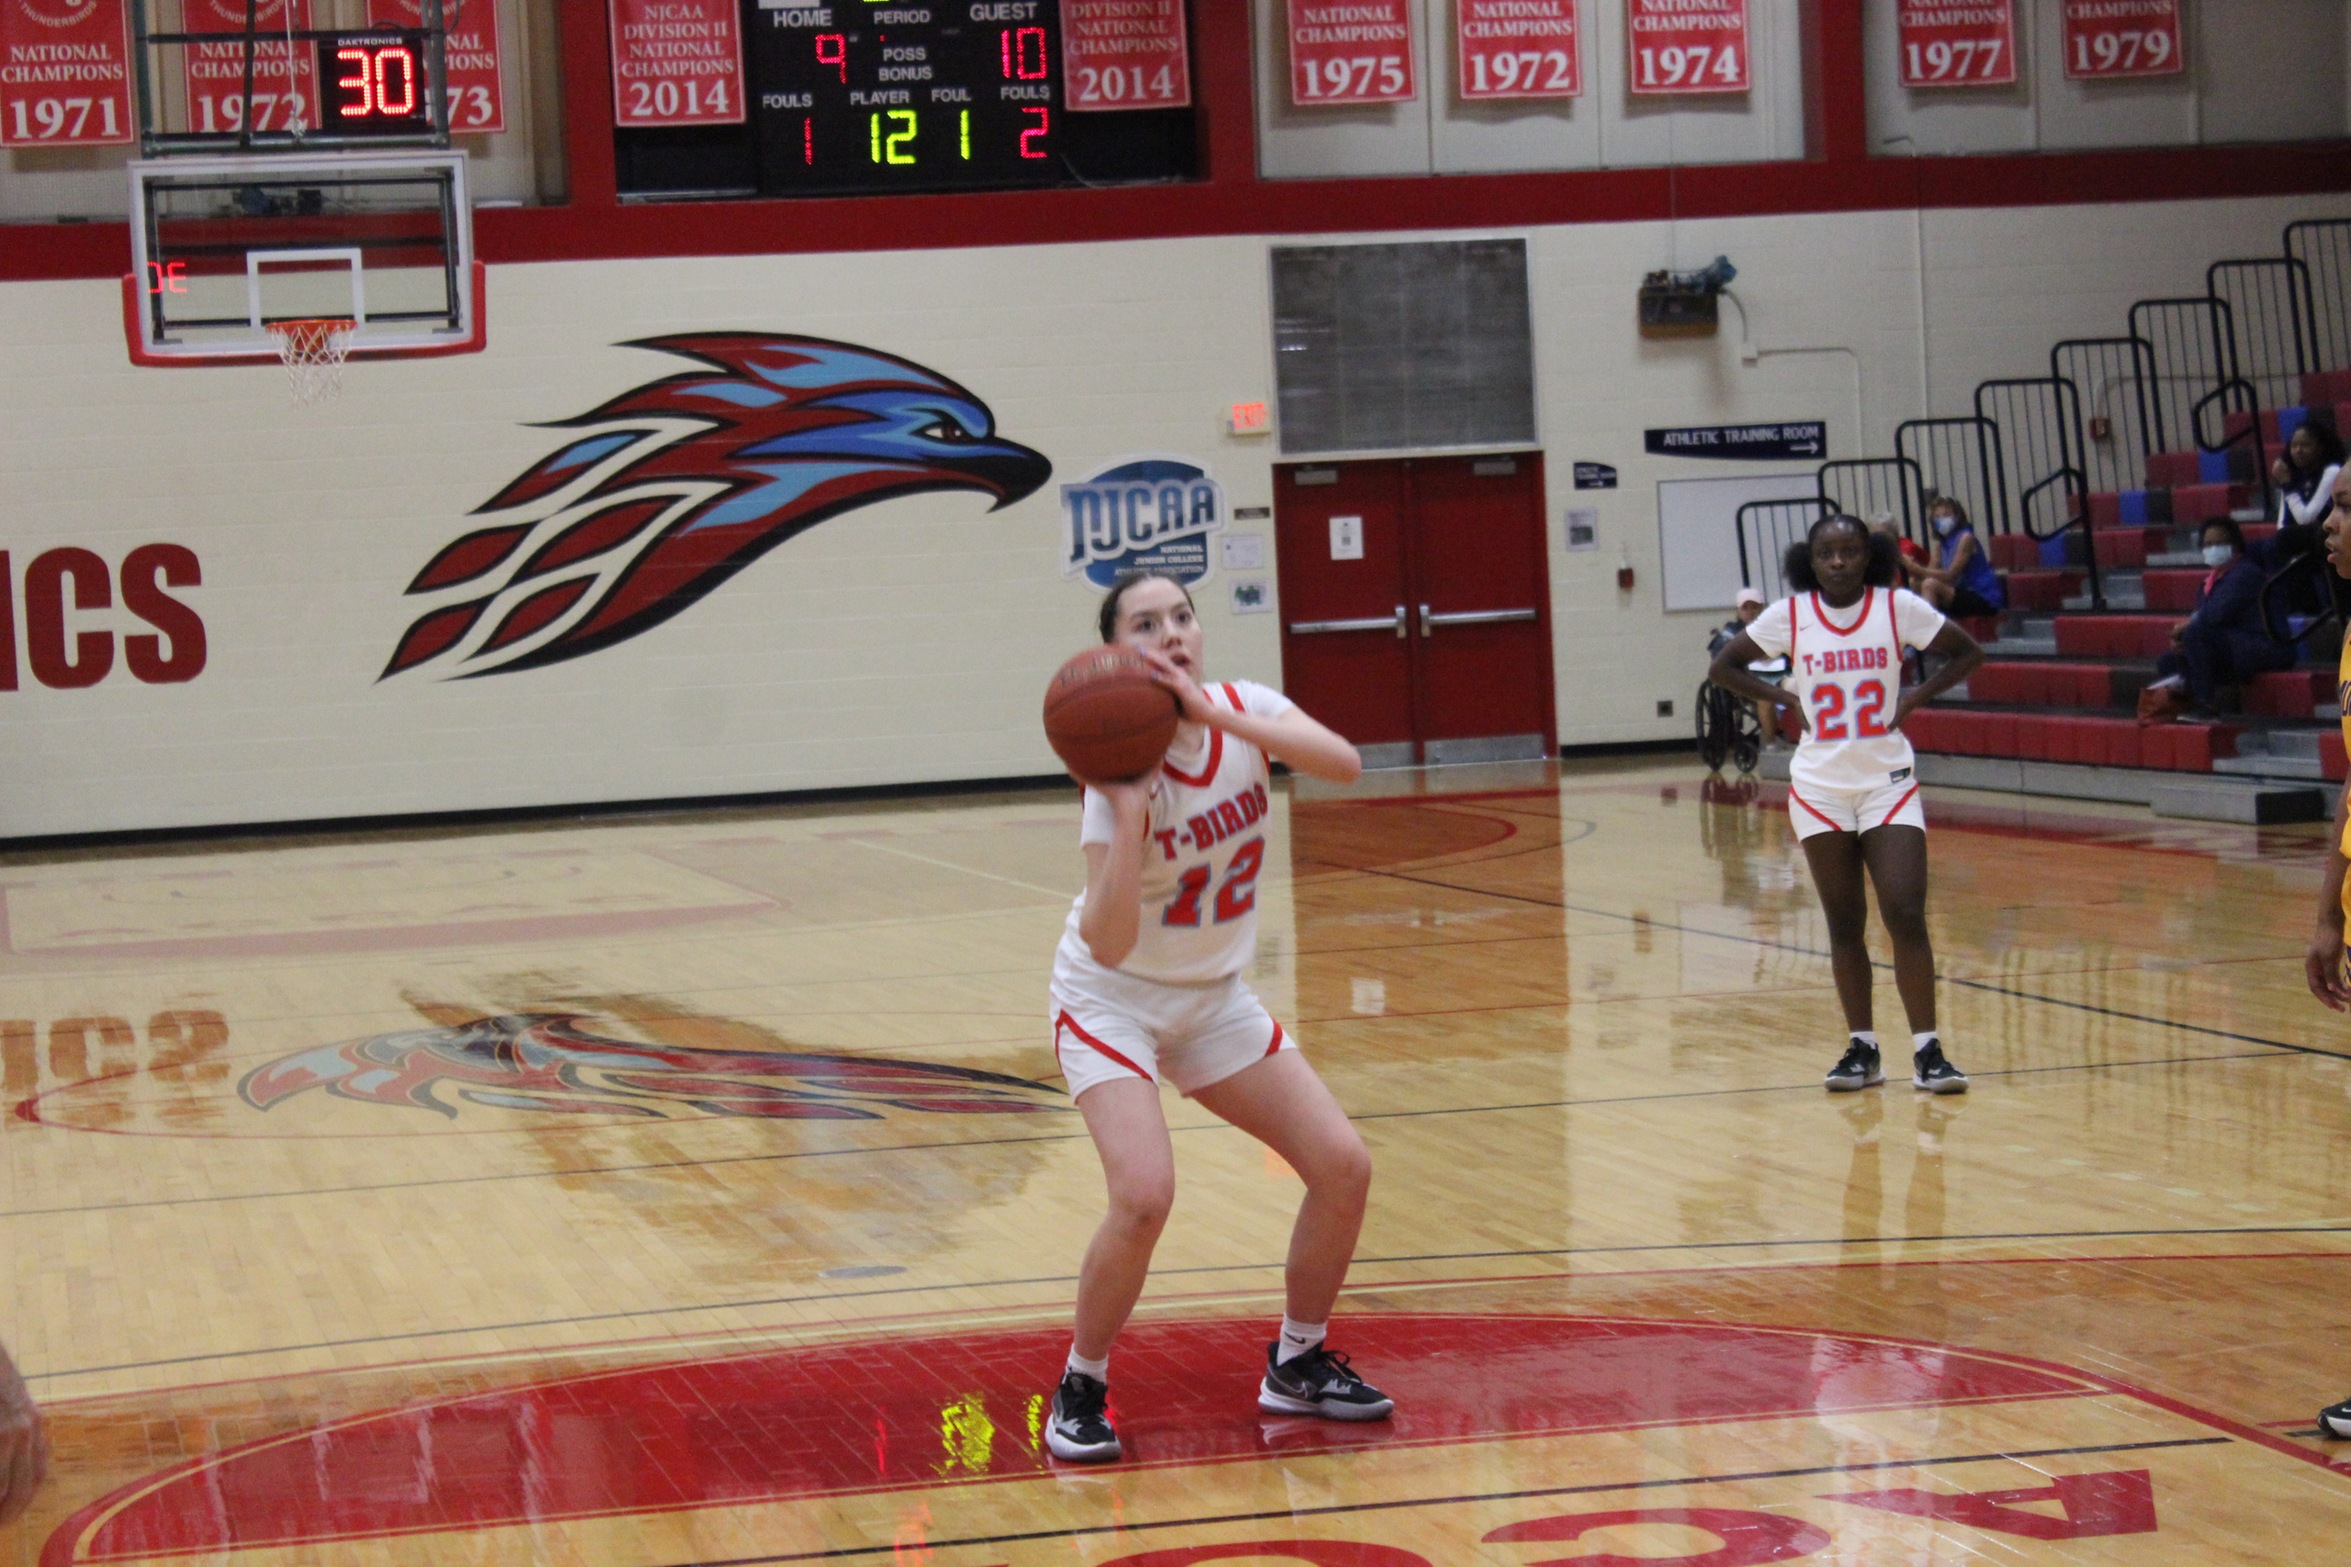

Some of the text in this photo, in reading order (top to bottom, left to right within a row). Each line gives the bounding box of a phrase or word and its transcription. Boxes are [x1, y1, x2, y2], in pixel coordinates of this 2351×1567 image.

[644, 4, 704, 21] NJCAA
[773, 9, 832, 28] HOME
[874, 10, 930, 24] PERIOD
[969, 3, 1037, 21] GUEST
[1071, 1, 1153, 18] DIVISION
[1304, 5, 1395, 24] NATIONAL
[1473, 1, 1563, 19] NATIONAL
[624, 21, 728, 40] DIVISION II
[1077, 20, 1168, 36] NATIONAL
[1464, 19, 1573, 38] CHAMPIONS
[1633, 13, 1742, 32] CHAMPIONS
[337, 37, 403, 47] DAKTRONICS
[1295, 23, 1406, 43] CHAMPIONS
[10, 43, 111, 62] NATIONAL
[629, 40, 726, 58] NATIONAL
[883, 47, 926, 62] POSS
[1001, 26, 1047, 80] 10
[1069, 37, 1178, 55] CHAMPIONS
[2075, 30, 2170, 71] 1979
[621, 59, 735, 77] CHAMPIONS
[815, 33, 847, 84] 9
[1640, 45, 1740, 86] 1974
[1906, 40, 2003, 80] 1977
[1, 64, 123, 83] CHAMPIONS
[878, 66, 932, 82] BONUS
[1303, 56, 1405, 97] 1975
[1471, 51, 1572, 91] 1972
[337, 48, 416, 118] 30
[1077, 65, 1175, 102] 2014
[629, 79, 730, 116] 2014
[762, 93, 812, 109] FOULS
[850, 90, 910, 106] PLAYER
[931, 88, 971, 103] FOUL
[1000, 85, 1050, 101] FOULS
[10, 97, 120, 139] 1971
[198, 93, 308, 132] 1972
[804, 117, 813, 165] 1
[871, 110, 917, 165] 12
[960, 109, 970, 160] 1
[1020, 107, 1048, 159] 2
[1663, 425, 1819, 447] ATHLETIC TRAINING ROOM
[1066, 483, 1216, 563] NJCAA
[1802, 647, 1888, 676] T-BIRDS
[1811, 678, 1889, 742] 22
[1155, 781, 1269, 860] T-BIRDS
[1161, 836, 1265, 928] 12
